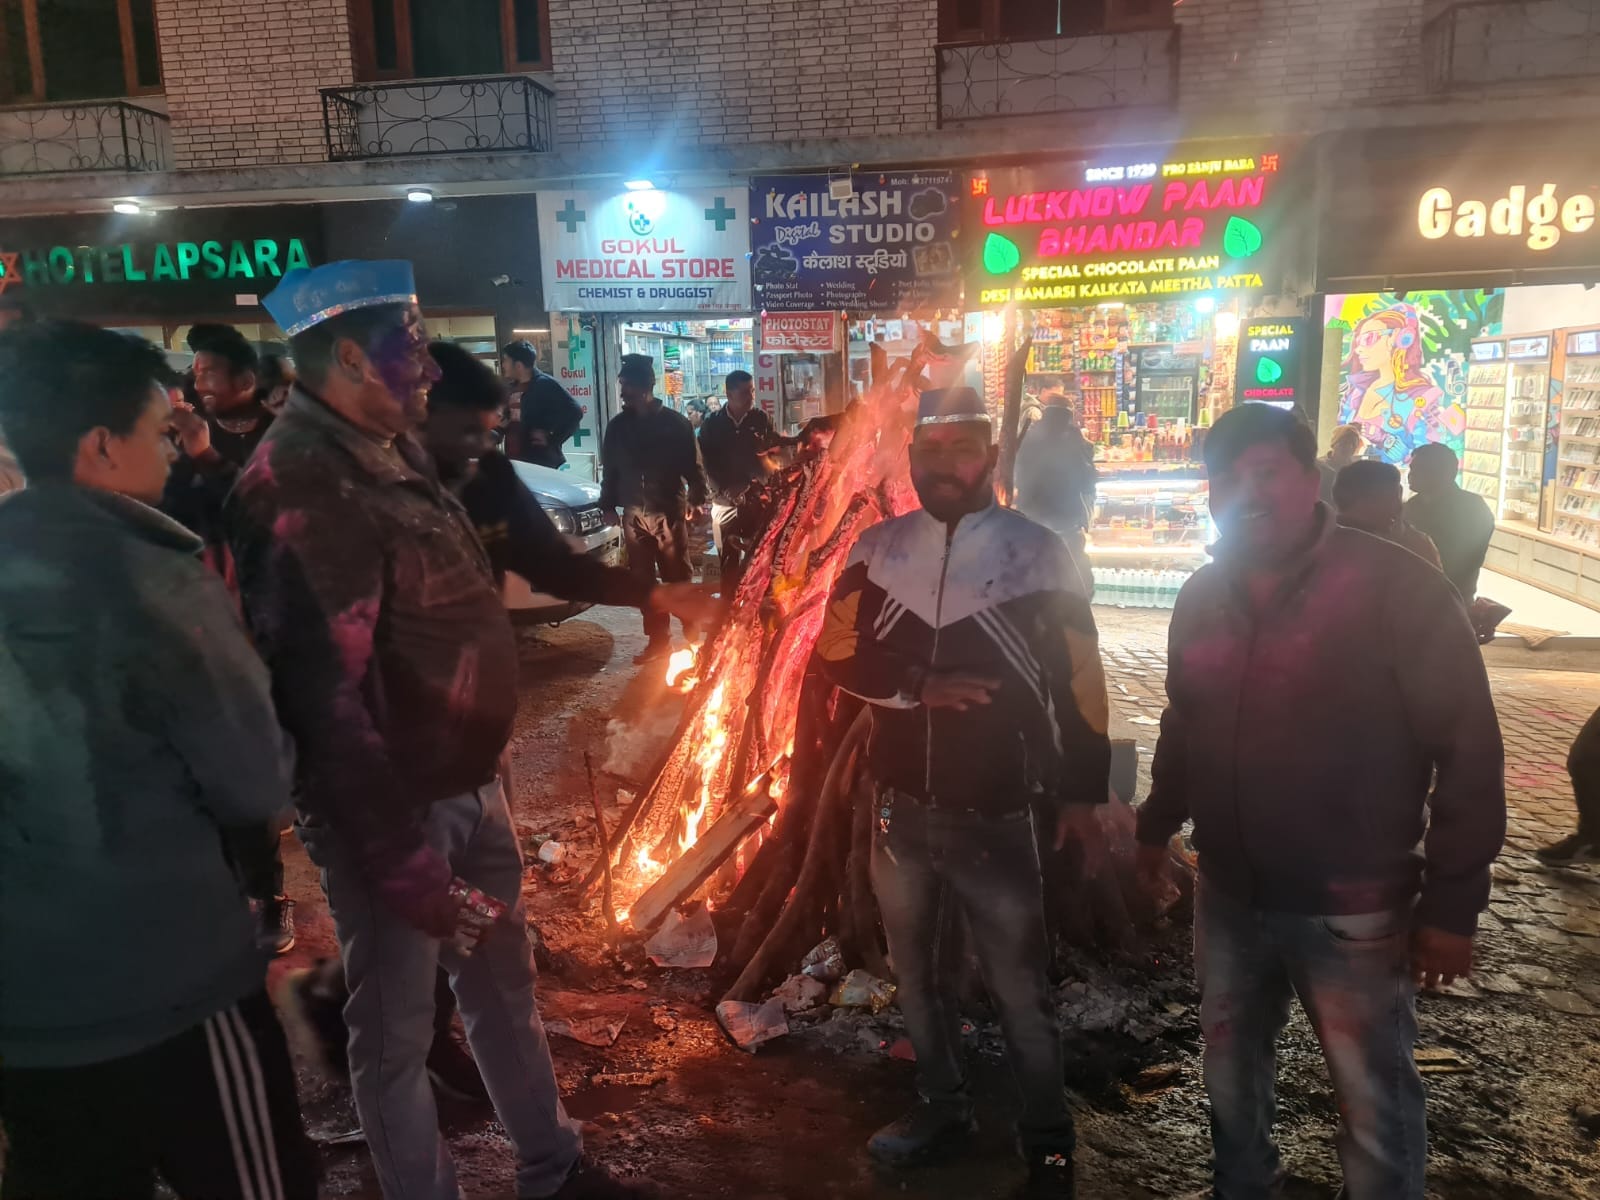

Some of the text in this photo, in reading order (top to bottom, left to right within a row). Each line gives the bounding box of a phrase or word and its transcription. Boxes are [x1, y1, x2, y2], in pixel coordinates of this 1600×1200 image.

[1085, 166, 1124, 182] SINCE
[1187, 160, 1222, 176] SANJU
[1224, 158, 1255, 172] BABA
[766, 190, 902, 220] KAILASH
[983, 176, 1265, 225] LUCKNOW PAAN
[775, 221, 935, 245] Digital STUDIO
[1038, 216, 1205, 257] BHANDAR
[601, 237, 685, 255] GOKUL
[23, 238, 312, 285] HOTEL APSARA
[556, 258, 735, 279] MEDICAL STORE
[803, 249, 907, 274] कैलाश स्टूडियो
[1021, 255, 1219, 280] SPECIAL CHOCOLATE PAAN
[578, 287, 714, 299] CHEMIST & DRUGGIST
[765, 281, 784, 290] Photo
[826, 281, 856, 290] Wedding
[981, 273, 1263, 303] DESI BANARSI KALKATA MEETHA PATTA
[766, 290, 813, 300] Passport Photo
[826, 290, 867, 300] Photography
[766, 300, 815, 309] Video Coverage
[766, 317, 830, 330] PHOTOSTAT
[1247, 325, 1294, 337] SPECIAL
[1250, 338, 1290, 351] PAAN
[561, 366, 586, 378] Gokul
[566, 384, 592, 396] dical
